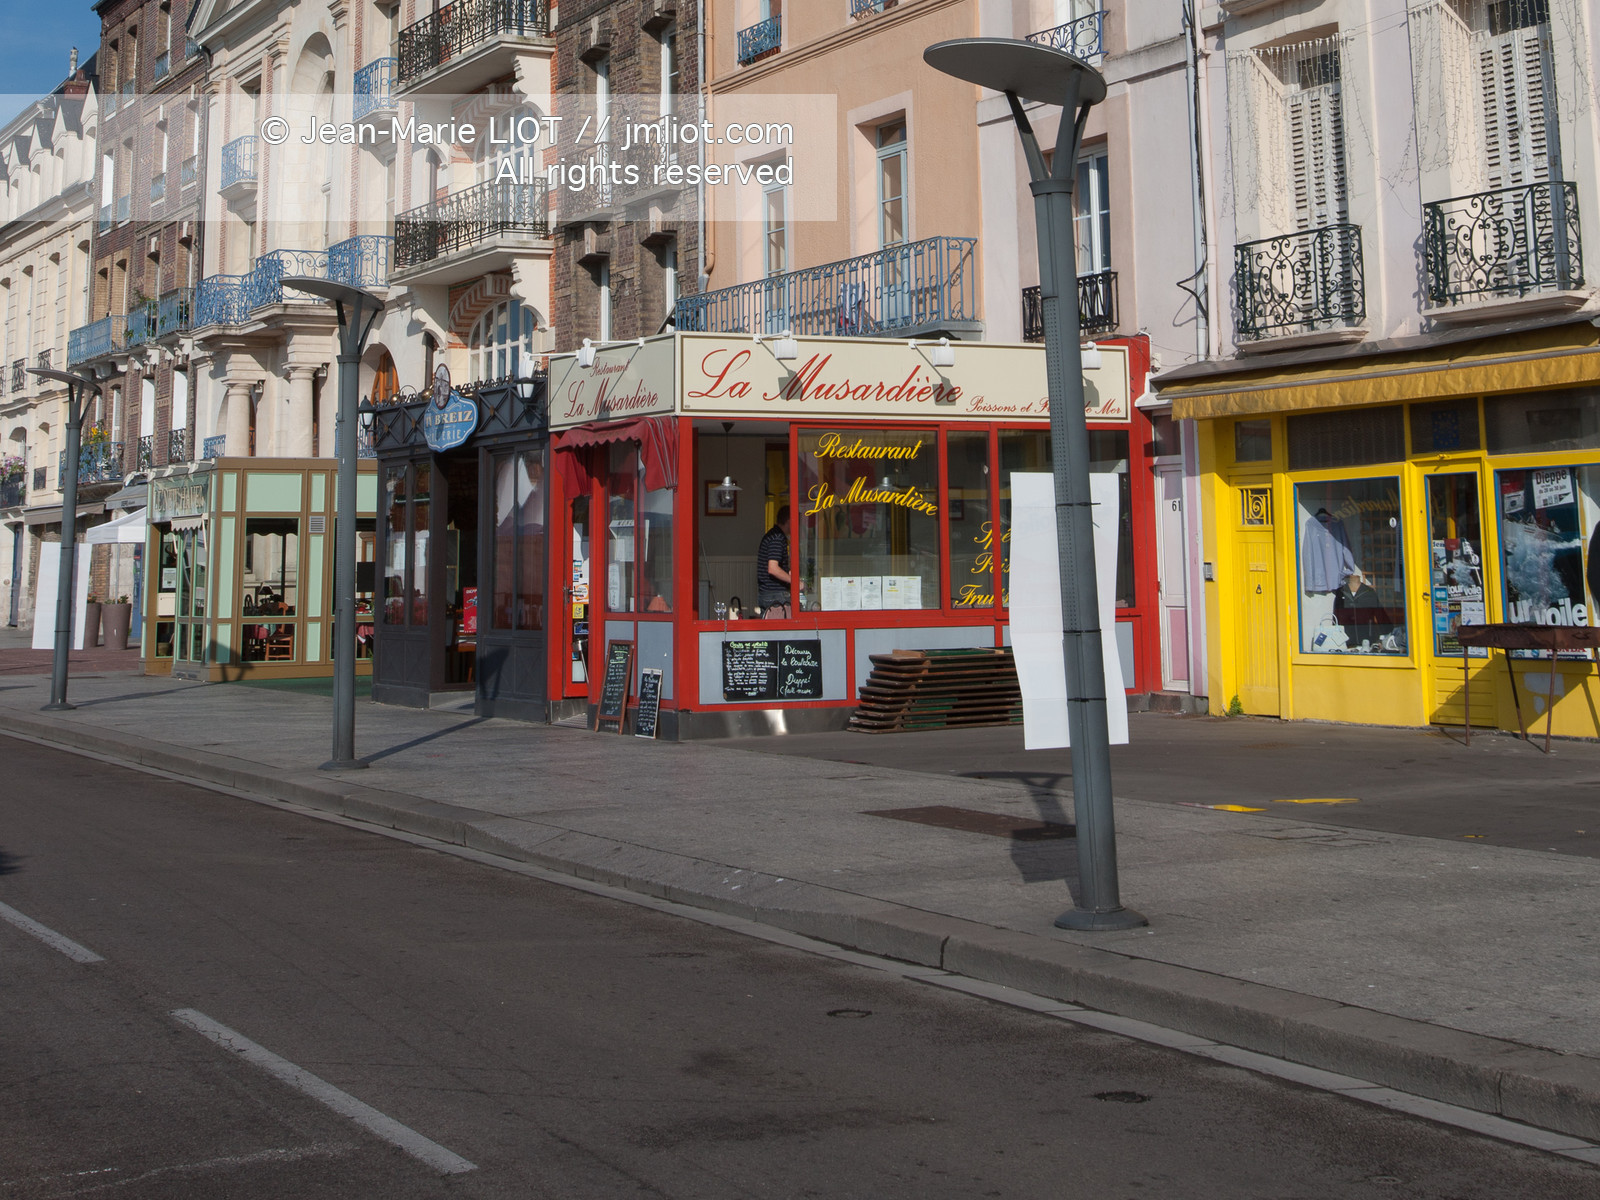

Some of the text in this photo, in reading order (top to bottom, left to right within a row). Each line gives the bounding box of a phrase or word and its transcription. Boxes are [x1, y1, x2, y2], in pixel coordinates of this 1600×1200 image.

[590, 357, 630, 377] Restaurant
[688, 349, 963, 403] La Musardière
[564, 377, 658, 418] La Musardière
[966, 395, 1017, 413] Poissons
[1020, 402, 1033, 413] et
[1095, 399, 1122, 415] Mer
[434, 410, 474, 425] BREIZ
[813, 432, 922, 460] Restaurant
[1536, 469, 1567, 485] Dieppe
[804, 476, 938, 517] La Musardière
[1171, 500, 1182, 512] 61
[1533, 597, 1587, 627] voile
